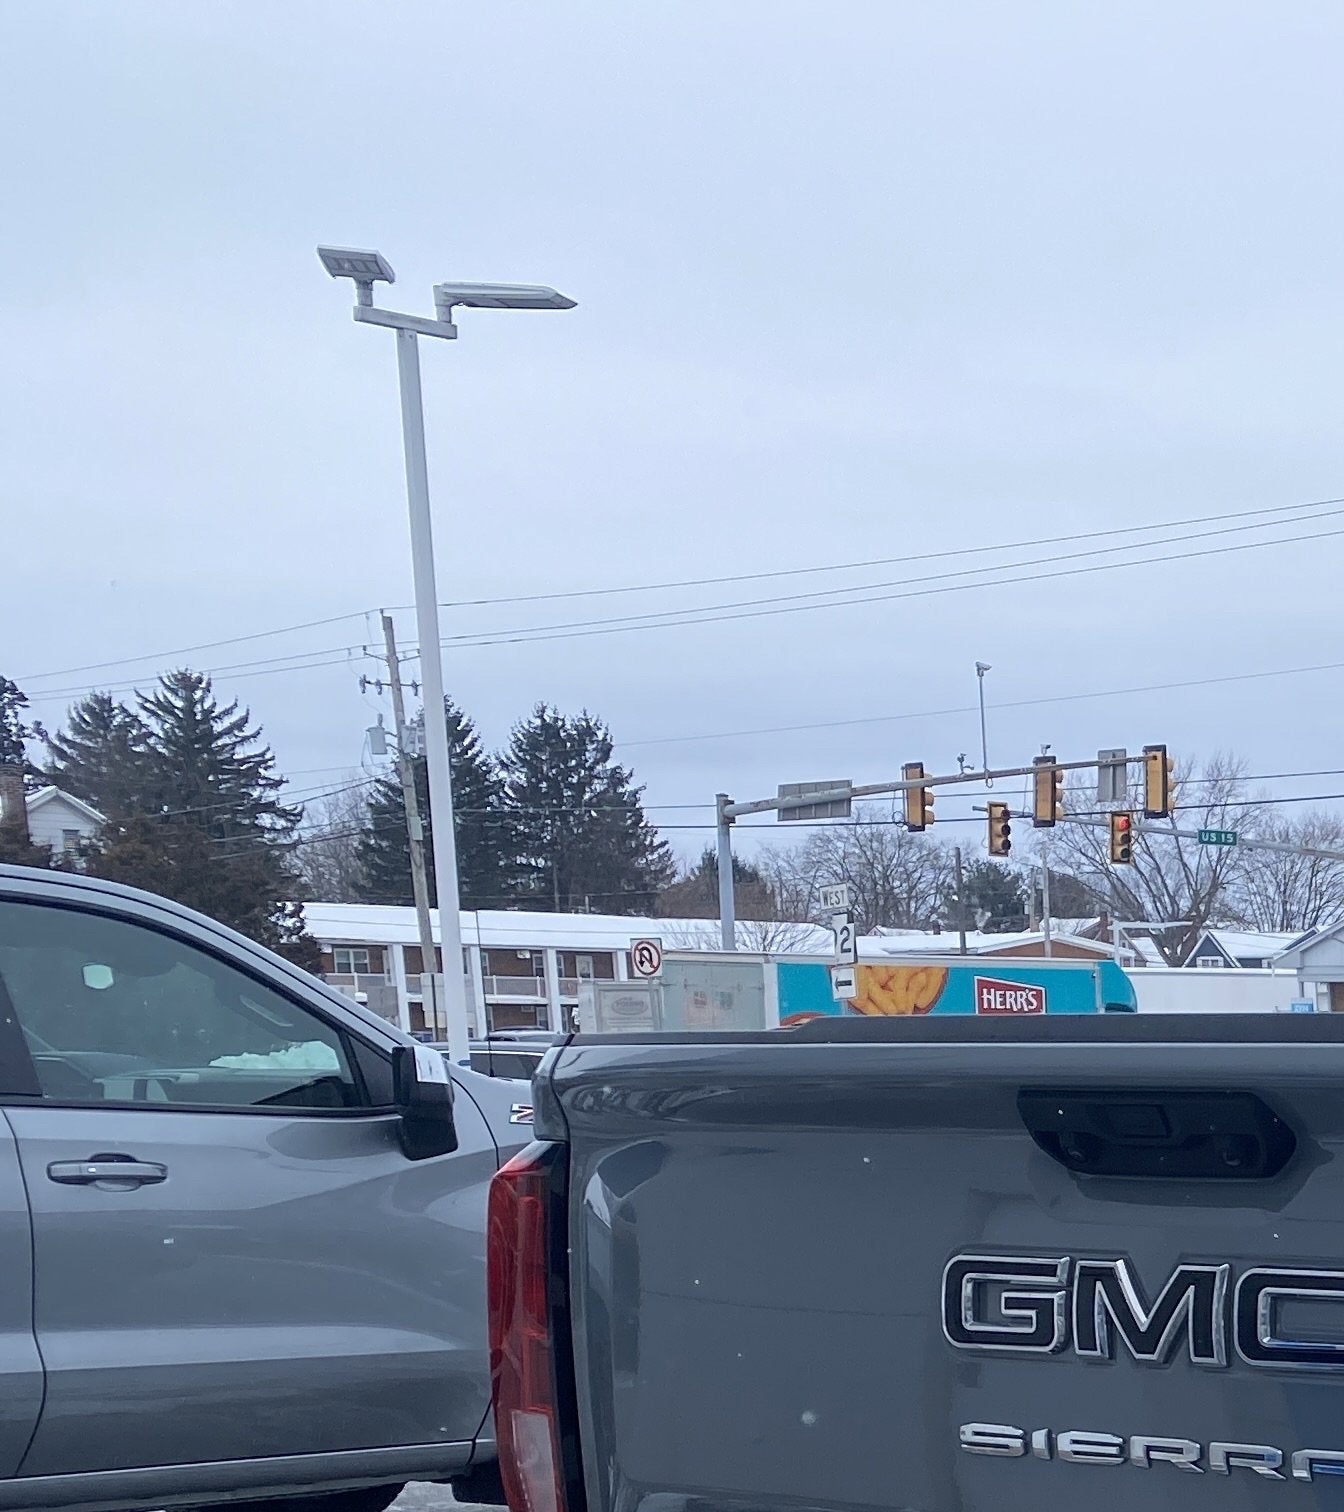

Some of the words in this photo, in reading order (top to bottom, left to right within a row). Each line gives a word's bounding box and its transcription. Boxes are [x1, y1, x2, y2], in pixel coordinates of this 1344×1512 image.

[1201, 832, 1217, 842] US
[1221, 833, 1234, 843] 15
[821, 889, 846, 907] WEST
[981, 987, 1038, 1011] HERR'S
